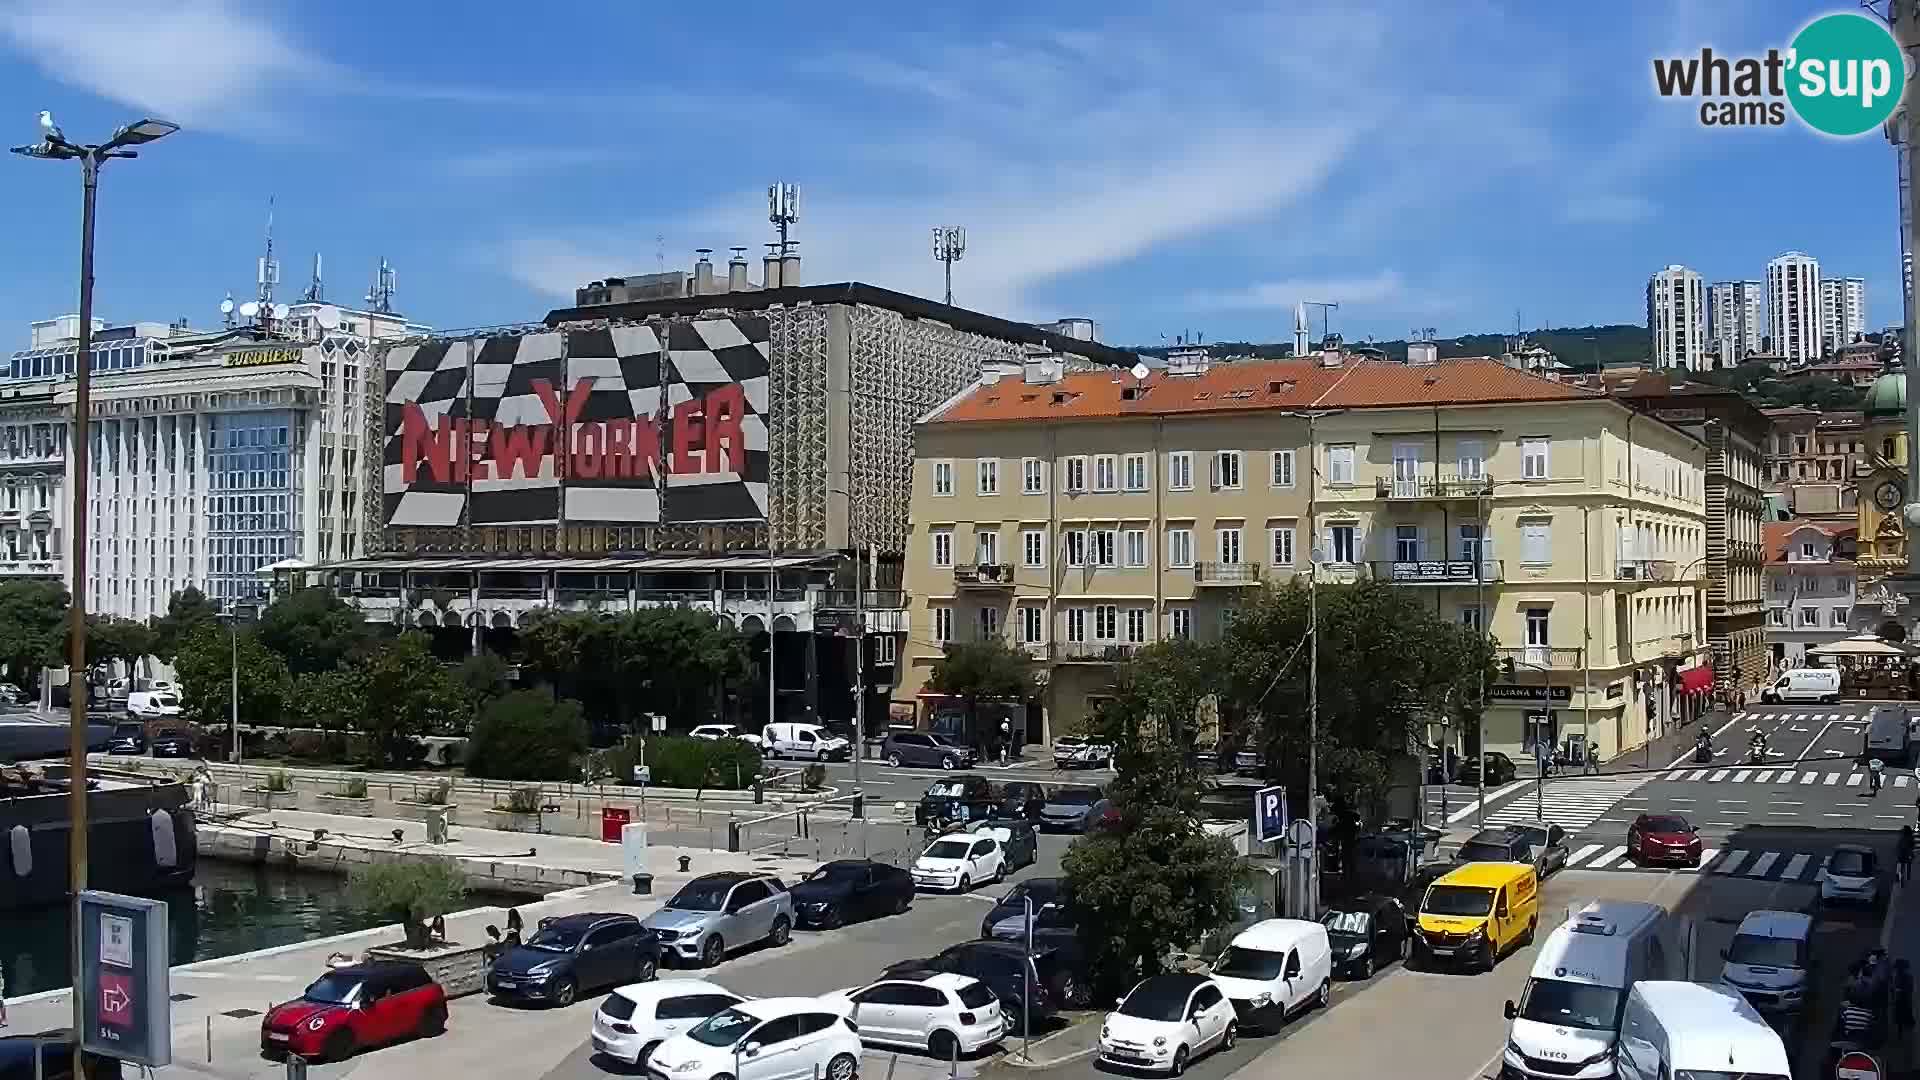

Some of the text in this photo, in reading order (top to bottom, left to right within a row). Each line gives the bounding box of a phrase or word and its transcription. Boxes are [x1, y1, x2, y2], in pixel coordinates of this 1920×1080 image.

[402, 399, 549, 484] NEW
[1266, 794, 1278, 818] P
[1539, 1048, 1568, 1060] IVECO
